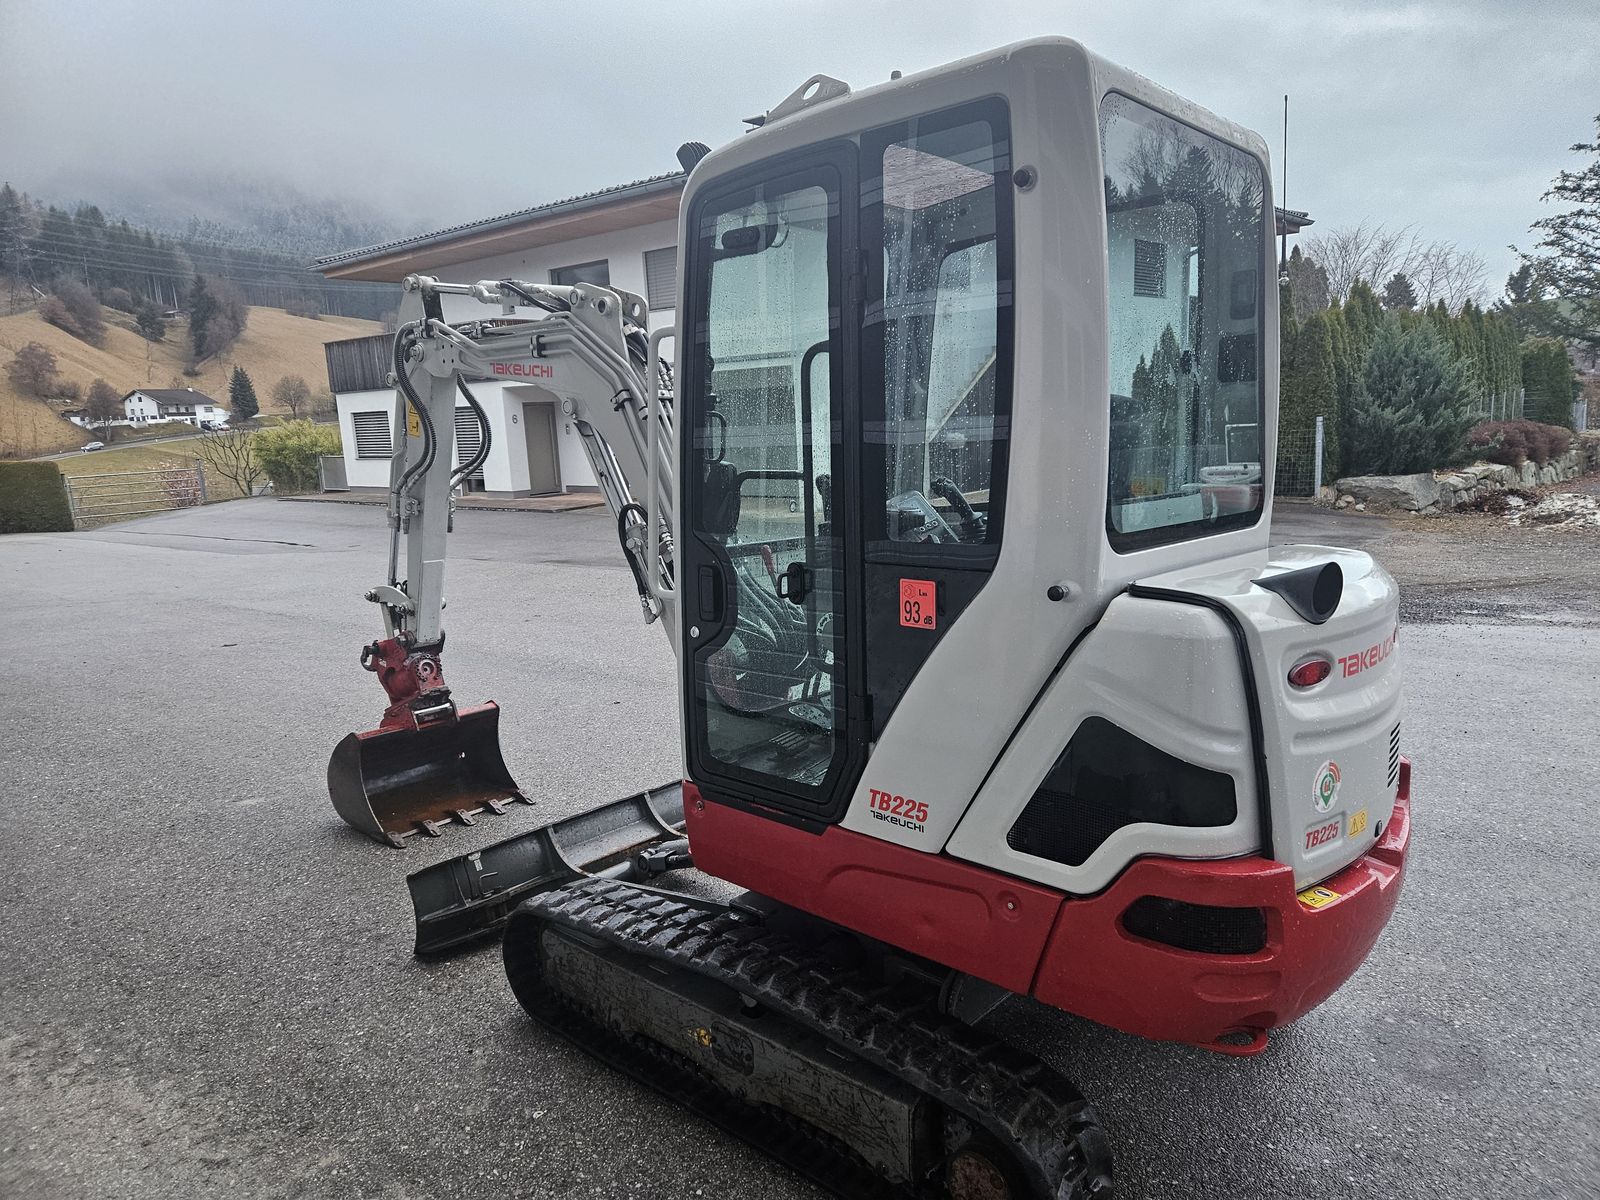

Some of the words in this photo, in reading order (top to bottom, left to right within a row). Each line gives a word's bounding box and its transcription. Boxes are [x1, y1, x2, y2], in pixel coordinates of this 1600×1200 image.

[511, 414, 518, 424] 6
[904, 600, 921, 624] 93
[923, 615, 933, 625] dB
[1337, 636, 1394, 679] TAKEUC
[869, 788, 929, 823] TB225
[1305, 820, 1340, 849] TB225
